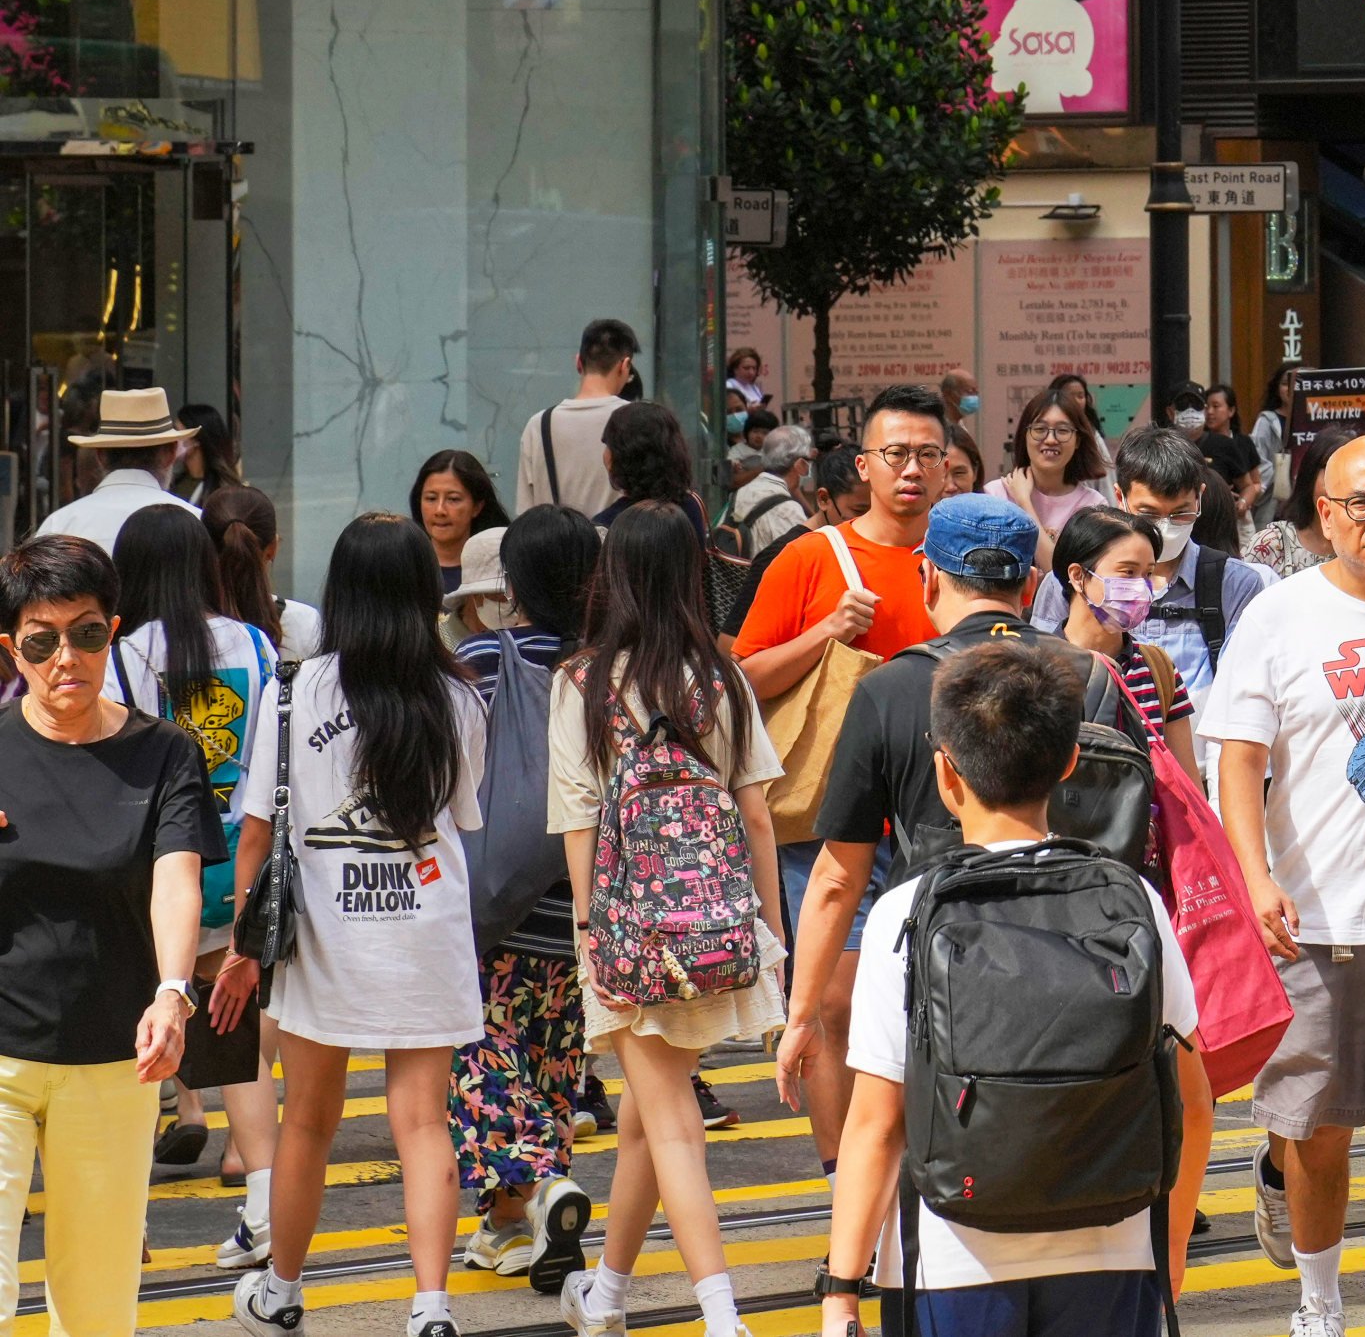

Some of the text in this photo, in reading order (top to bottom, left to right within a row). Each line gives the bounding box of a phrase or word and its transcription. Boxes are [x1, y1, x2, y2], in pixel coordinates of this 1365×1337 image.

[1184, 171, 1280, 183] East Point Road
[734, 197, 770, 211] Road
[1207, 190, 1256, 205] 東角道
[1307, 401, 1361, 421] YAKINIKU
[634, 854, 666, 879] 30
[342, 862, 415, 891] DUNK
[335, 889, 422, 912] 'EM LOW.
[1195, 893, 1227, 910] Pharm
[342, 915, 360, 923] Oven
[361, 915, 378, 923] fresh,
[379, 914, 401, 923] served
[690, 921, 712, 933] LOVE
[717, 962, 737, 977] LOVE
